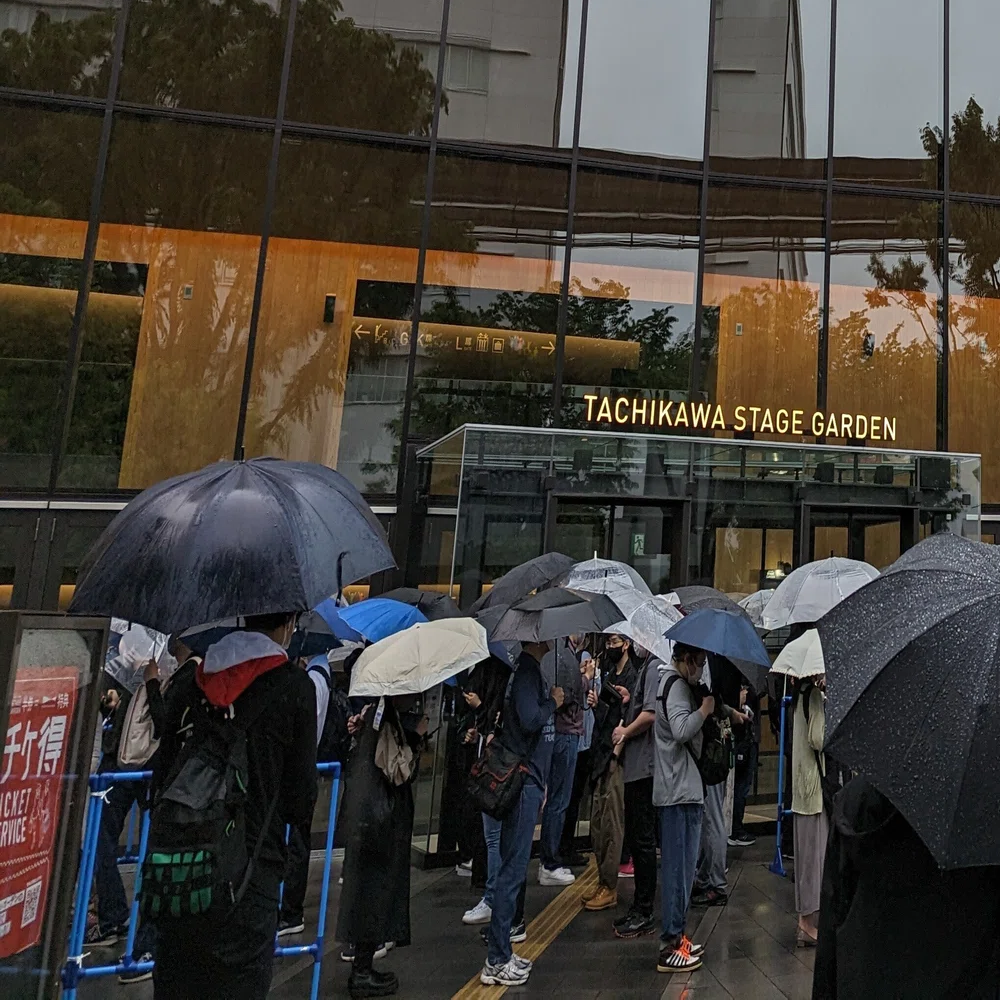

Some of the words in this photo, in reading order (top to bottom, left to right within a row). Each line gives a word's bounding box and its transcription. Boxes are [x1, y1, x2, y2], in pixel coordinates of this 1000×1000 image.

[583, 394, 726, 430] TACHIKAWA
[733, 405, 804, 436] STAGE
[811, 411, 897, 441] GARDEN
